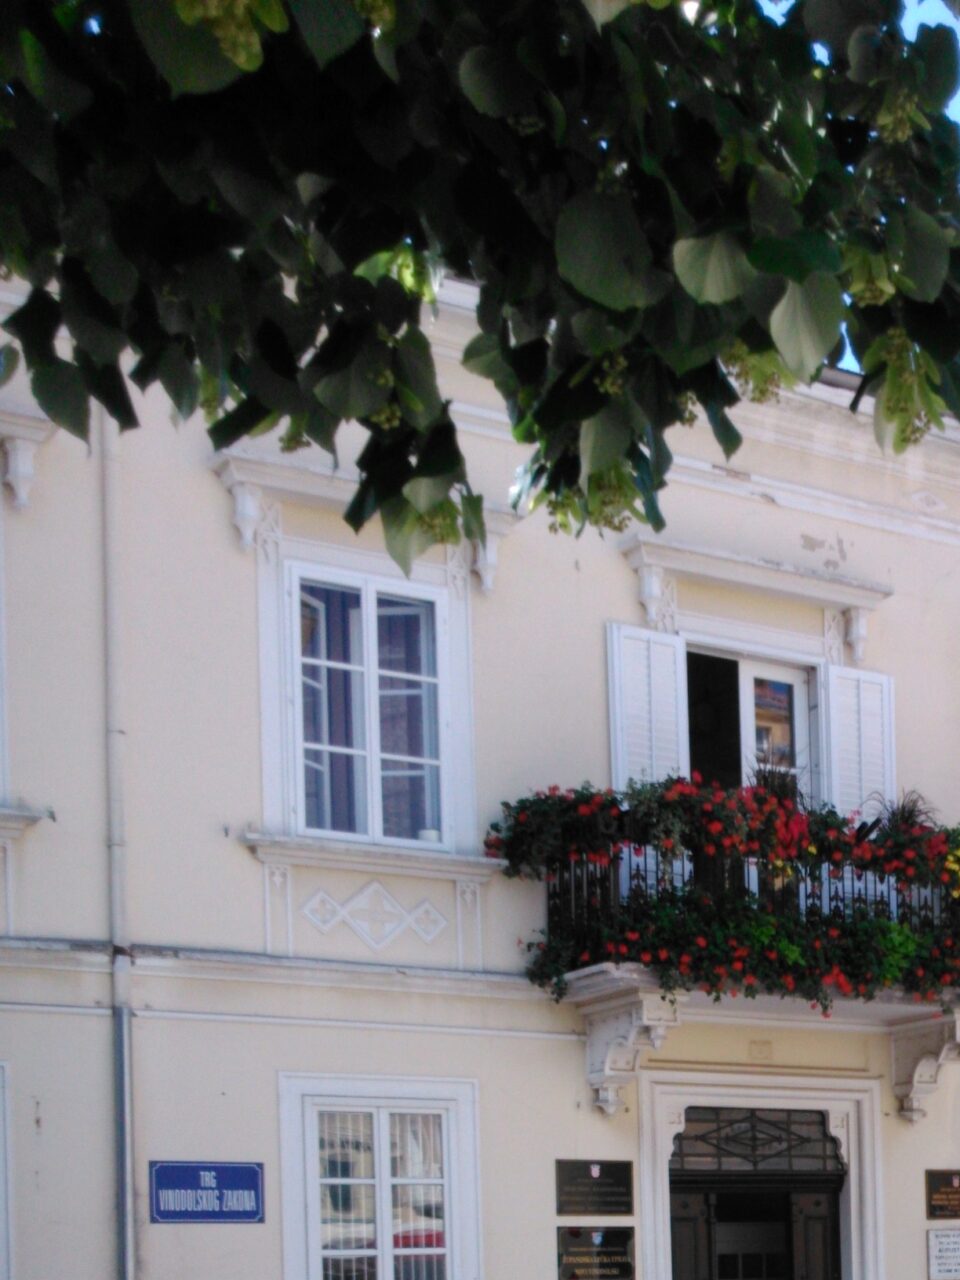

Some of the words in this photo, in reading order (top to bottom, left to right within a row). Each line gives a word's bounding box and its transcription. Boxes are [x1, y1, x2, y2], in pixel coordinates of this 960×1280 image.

[199, 1171, 217, 1188] TRG
[159, 1189, 220, 1211] VINODOLSKOG
[222, 1190, 257, 1211] ZAKONA
